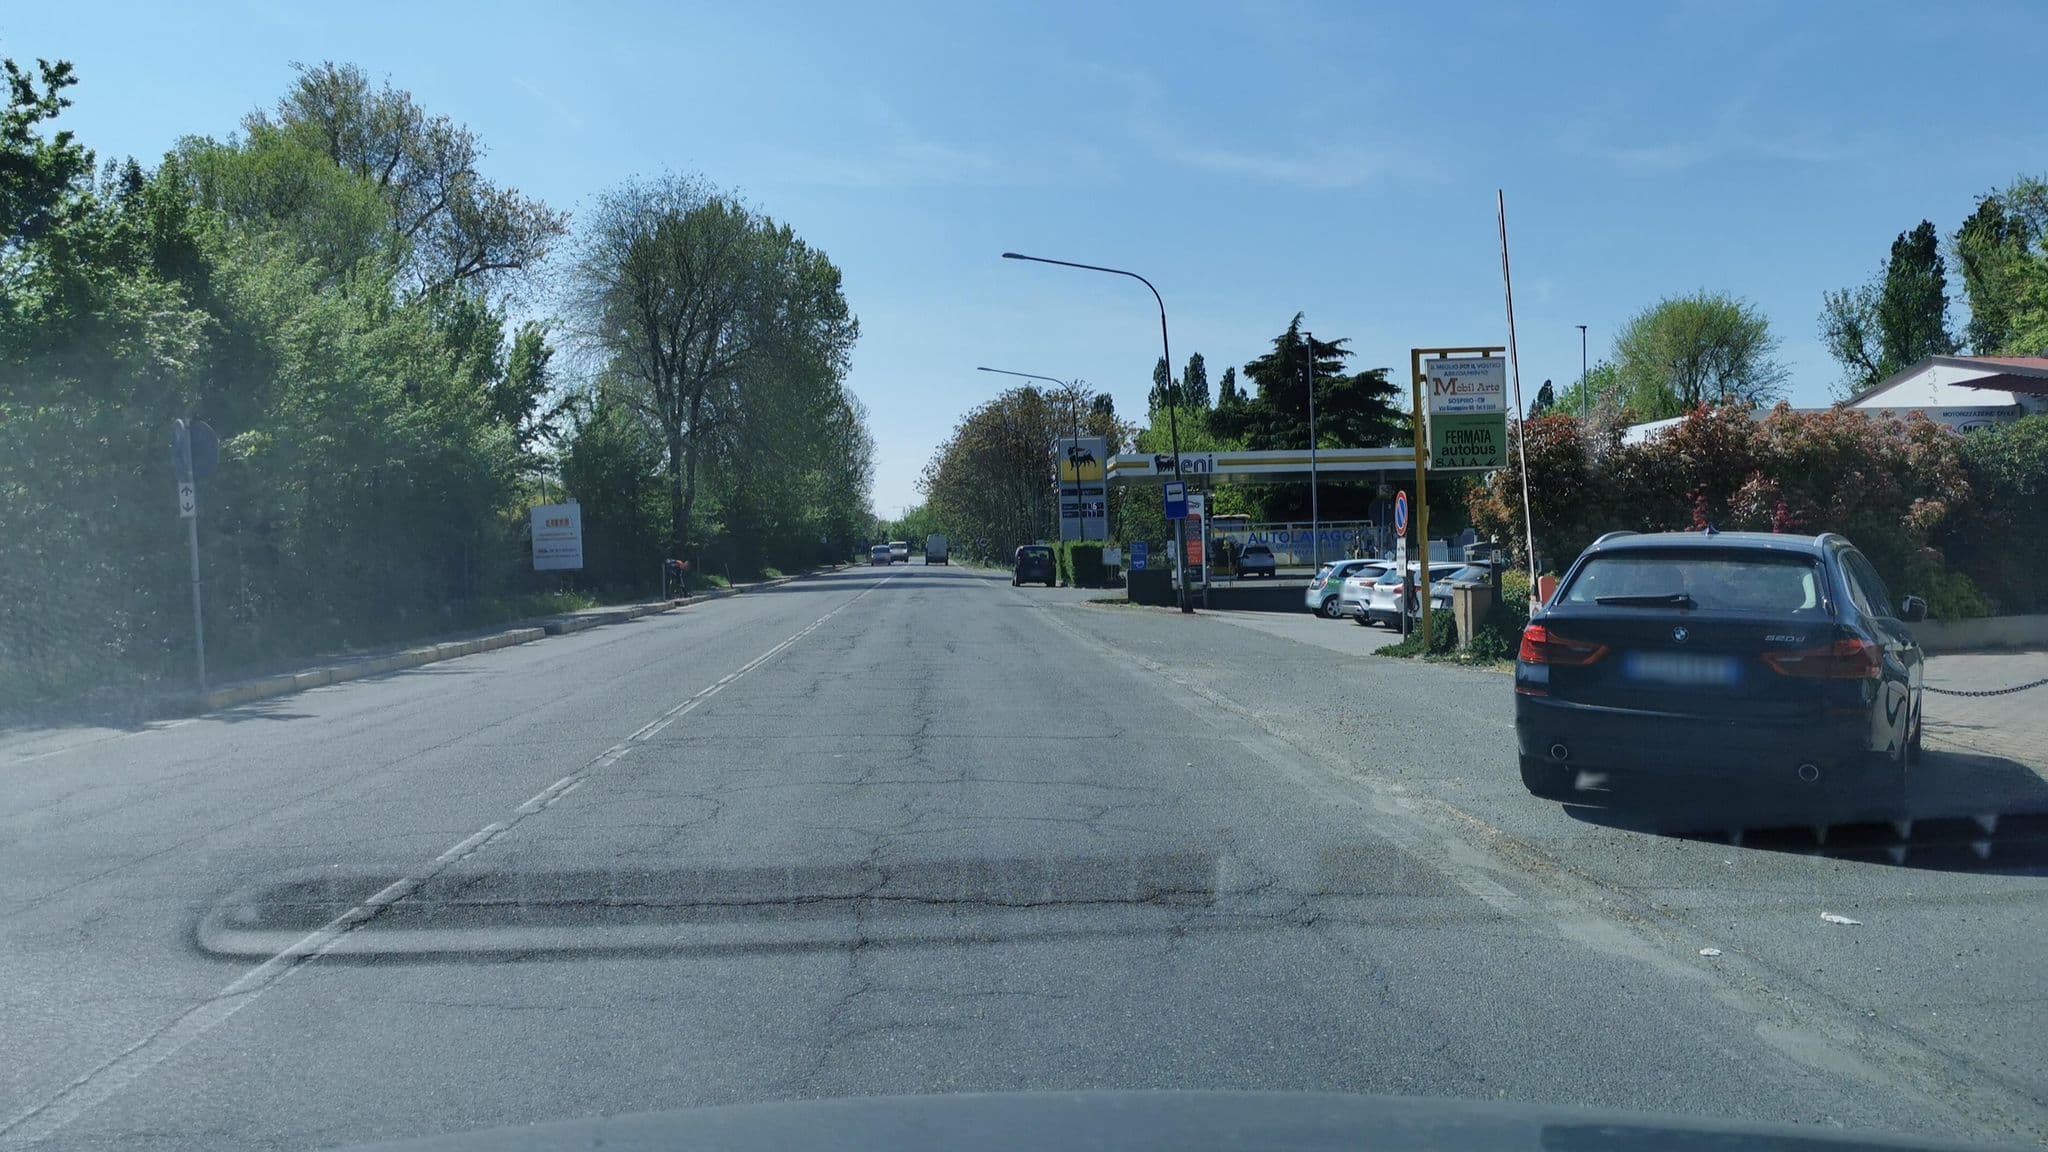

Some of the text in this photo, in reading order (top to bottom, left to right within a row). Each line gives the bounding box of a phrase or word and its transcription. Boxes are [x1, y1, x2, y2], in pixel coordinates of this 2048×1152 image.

[1445, 428, 1492, 444] FERMATA
[1441, 443, 1497, 456] autobus
[1181, 453, 1213, 473] eni
